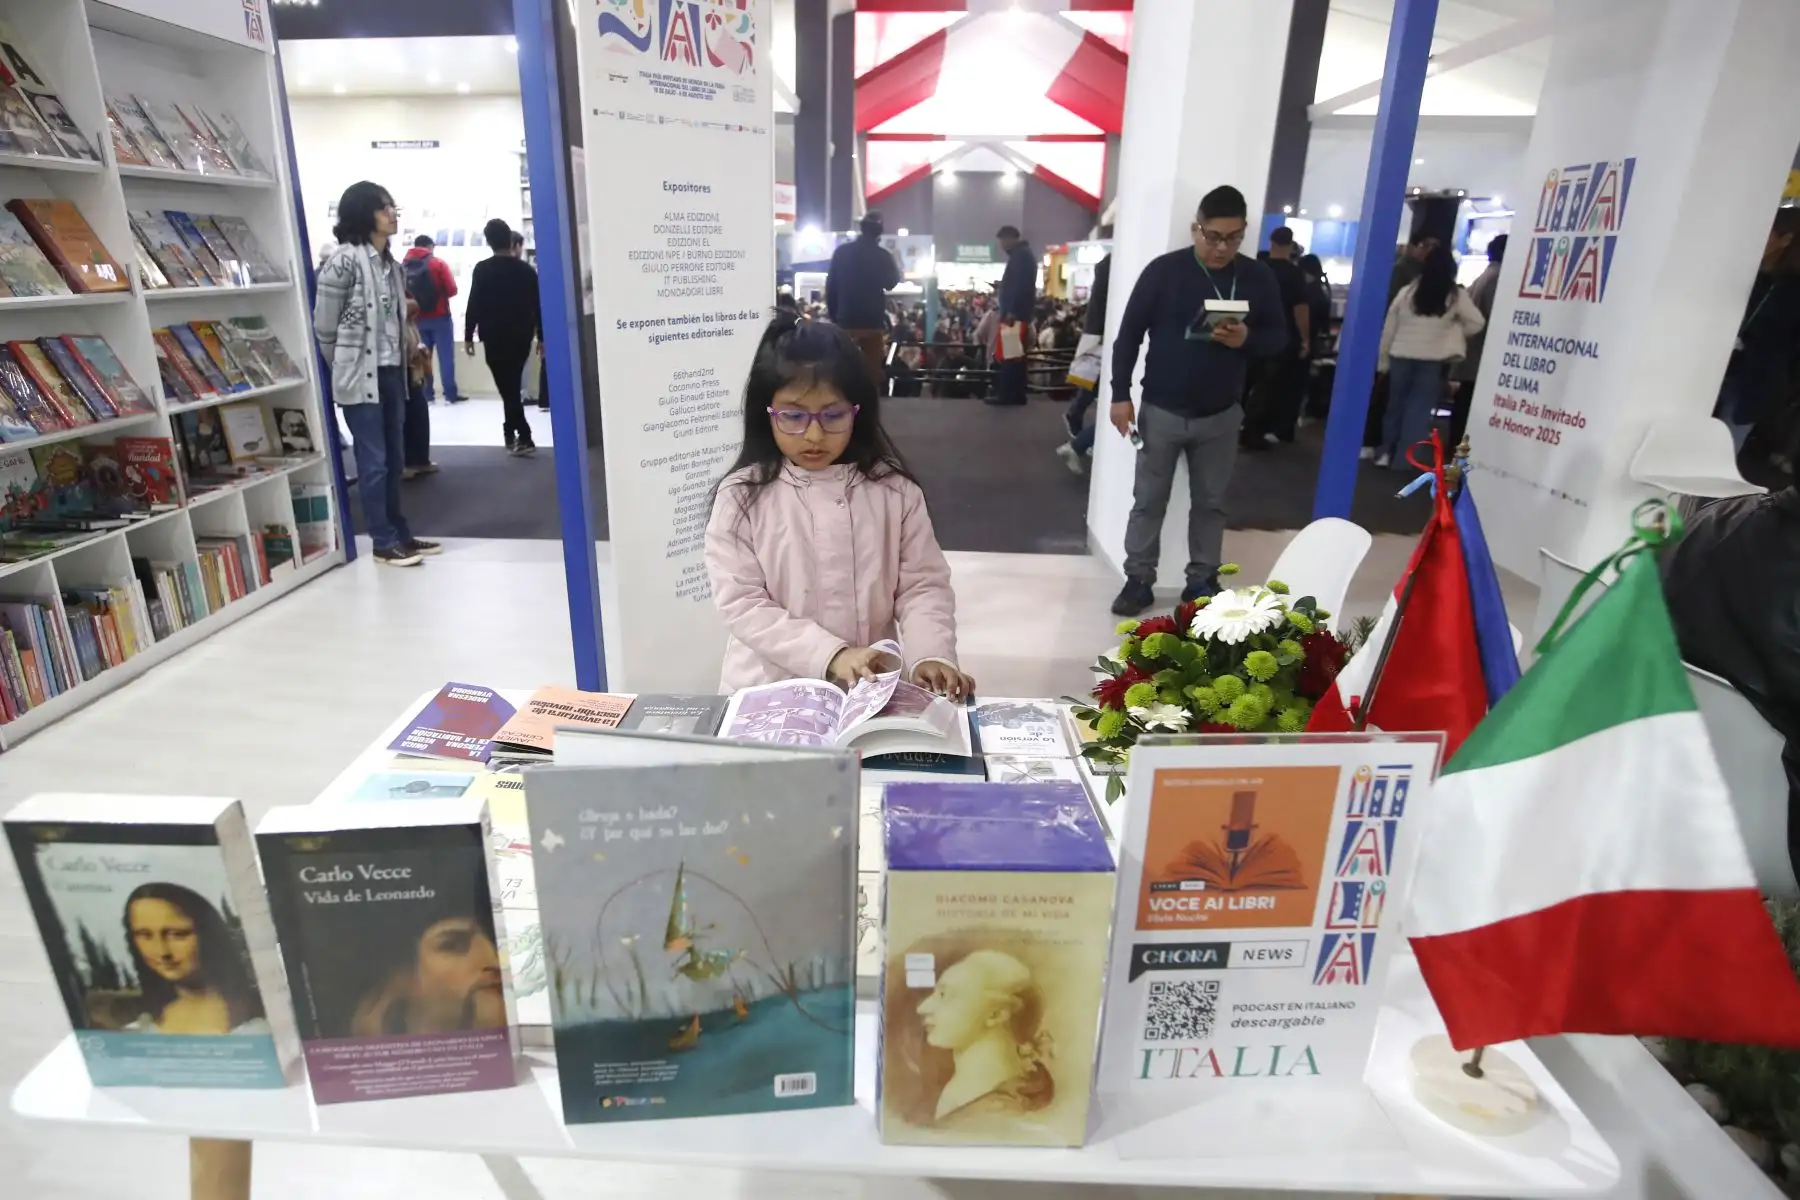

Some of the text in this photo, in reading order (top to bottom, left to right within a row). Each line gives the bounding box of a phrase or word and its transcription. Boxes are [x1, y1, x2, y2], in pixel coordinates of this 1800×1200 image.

[663, 181, 711, 194] Expositores
[664, 212, 720, 222] ALMA EDIZIONI
[653, 225, 723, 235] DONZELLI EDITORE
[667, 238, 700, 247] EDIZIONI
[628, 251, 664, 260] EDIZIONI
[666, 251, 681, 260] NPE
[715, 250, 746, 259] EDIZIONI
[641, 262, 735, 273] GIULIO PERRONE EDITORE
[672, 274, 717, 284] PUBLISHING
[657, 287, 704, 298] MONDADORI
[616, 309, 759, 331] Se exponen también los libros de las
[1512, 310, 1541, 327] FERIA
[648, 327, 734, 346] siguientes editoriales:
[1507, 332, 1599, 359] INTERNACIONAL
[1502, 352, 1556, 375] DEL LIBRO
[702, 379, 720, 388] Press
[1498, 373, 1540, 394] DE LIMA
[706, 389, 729, 398] Editore
[697, 401, 720, 412] editore
[1493, 393, 1517, 412] Italia
[1541, 404, 1586, 429] Invitado
[695, 424, 718, 435] Editore
[1488, 412, 1562, 446] de Honor 2025
[640, 457, 668, 468] Gruppo
[299, 864, 412, 884] Carlo Vecce
[303, 886, 436, 904] Vida de Leonardo
[935, 894, 1075, 905] GIACOMO CASANOVA
[1149, 896, 1276, 911] VOCE AI LIBRI
[1141, 948, 1293, 964] CHORA NEWS
[1232, 1000, 1356, 1012] PODCAST EN ITALIANO
[1230, 1015, 1325, 1030] descargable
[1135, 1044, 1321, 1080] ITALIA
